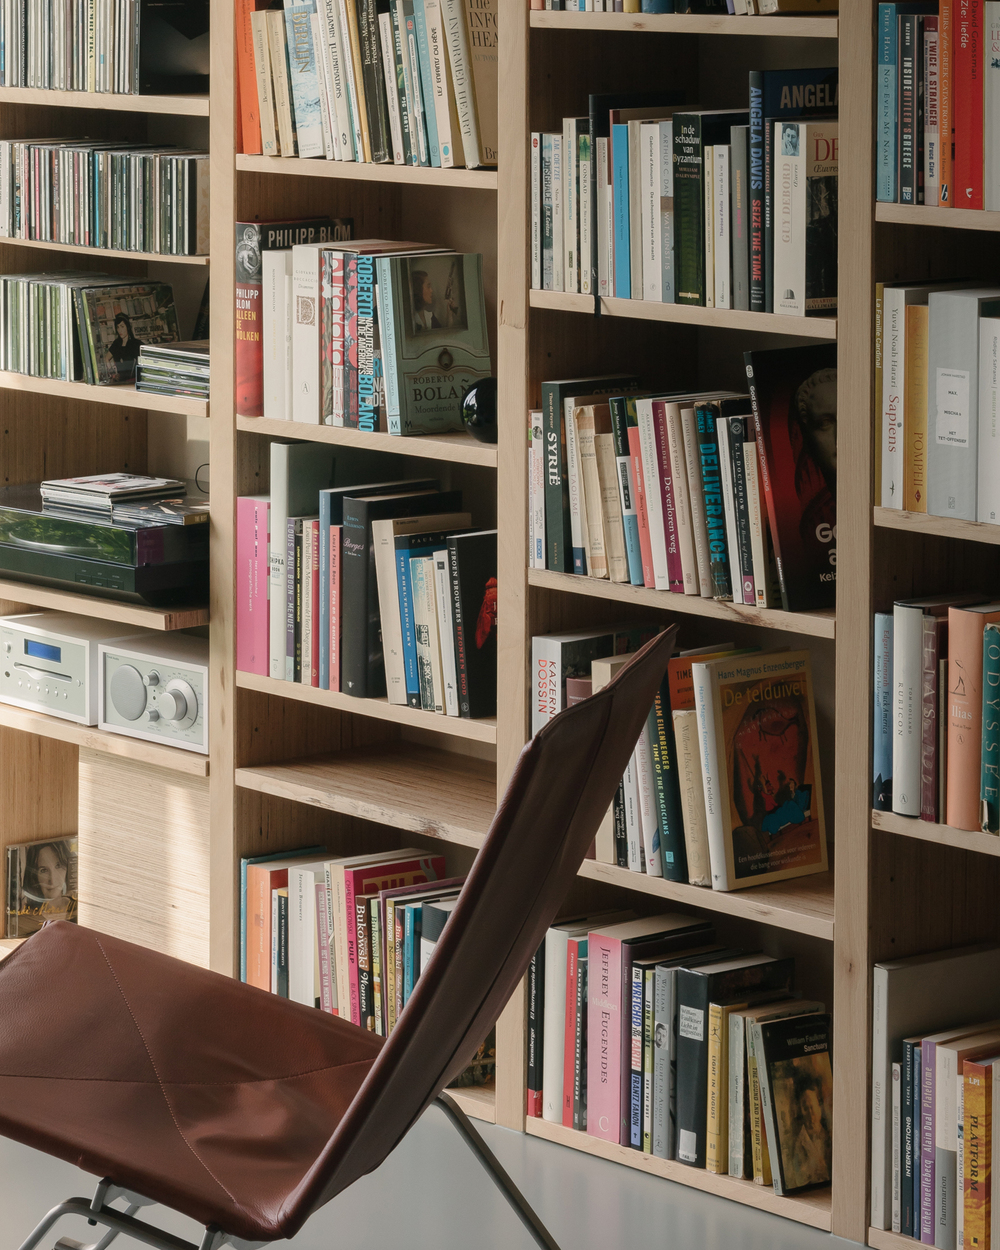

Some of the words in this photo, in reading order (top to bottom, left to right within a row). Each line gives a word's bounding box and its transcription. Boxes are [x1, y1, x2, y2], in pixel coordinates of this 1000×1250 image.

[960, 0, 968, 19] Zie:
[291, 10, 311, 74] BERLIJN
[960, 22, 969, 49] liefde
[433, 45, 439, 57] DU
[929, 40, 938, 68] TWICE
[434, 57, 442, 84] ENFANTS
[750, 86, 763, 144] ANGELA
[929, 79, 937, 126] STRANGER
[675, 134, 701, 145] schaduw
[681, 125, 687, 135] In
[688, 125, 695, 135] de
[672, 154, 702, 165] Byzantium
[683, 146, 694, 154] van
[750, 149, 763, 190] DAVIS
[782, 162, 792, 217] DEBORD
[752, 199, 762, 229] SEIZE
[268, 227, 315, 247] PHILIPP
[319, 224, 351, 242] BLOM
[752, 231, 762, 251] THE
[781, 221, 791, 244] GUY
[752, 253, 762, 282] TIME
[357, 255, 373, 317] ROBERTO
[891, 308, 899, 332] Yuval
[891, 334, 899, 357] Noah
[413, 375, 455, 385] ROBERTO
[890, 358, 898, 388] Harari
[359, 374, 378, 432] BOLAÑO
[885, 394, 900, 454] Sapiens
[547, 432, 561, 486] SYRIË
[913, 431, 924, 487] POMPEII
[664, 477, 671, 491] De
[664, 494, 675, 532] verloren
[699, 443, 727, 564] DELIVERANCE
[343, 537, 364, 552] Borges
[668, 533, 677, 554] weg
[449, 546, 457, 577] JEROEN
[453, 580, 462, 623] BROUWERS
[456, 626, 465, 670] BEZONKEN
[717, 670, 735, 681] Hans
[736, 665, 762, 678] Magnus
[763, 659, 806, 673] Enzensberger
[537, 659, 548, 714] DOSSIN
[723, 689, 743, 708] De
[745, 680, 805, 703] telduivel
[951, 704, 973, 722] Ilias
[657, 718, 670, 770] EILENBERGER
[655, 763, 661, 774] OF
[658, 792, 670, 836] MAGICIANS
[356, 904, 369, 969] Bukowski
[600, 946, 611, 998] JEFFREY
[360, 971, 369, 1012] Women
[631, 982, 642, 1027] WRETCHED
[600, 1010, 611, 1085] EUGENIDES
[787, 1037, 805, 1046] William
[805, 1033, 827, 1043] Faulkner
[804, 1042, 827, 1052] Sanctuary
[632, 1075, 640, 1100] FRANTZ
[922, 1066, 933, 1110] Plateforme
[631, 1101, 639, 1127] FANON
[970, 1114, 979, 1192] PLATFORM
